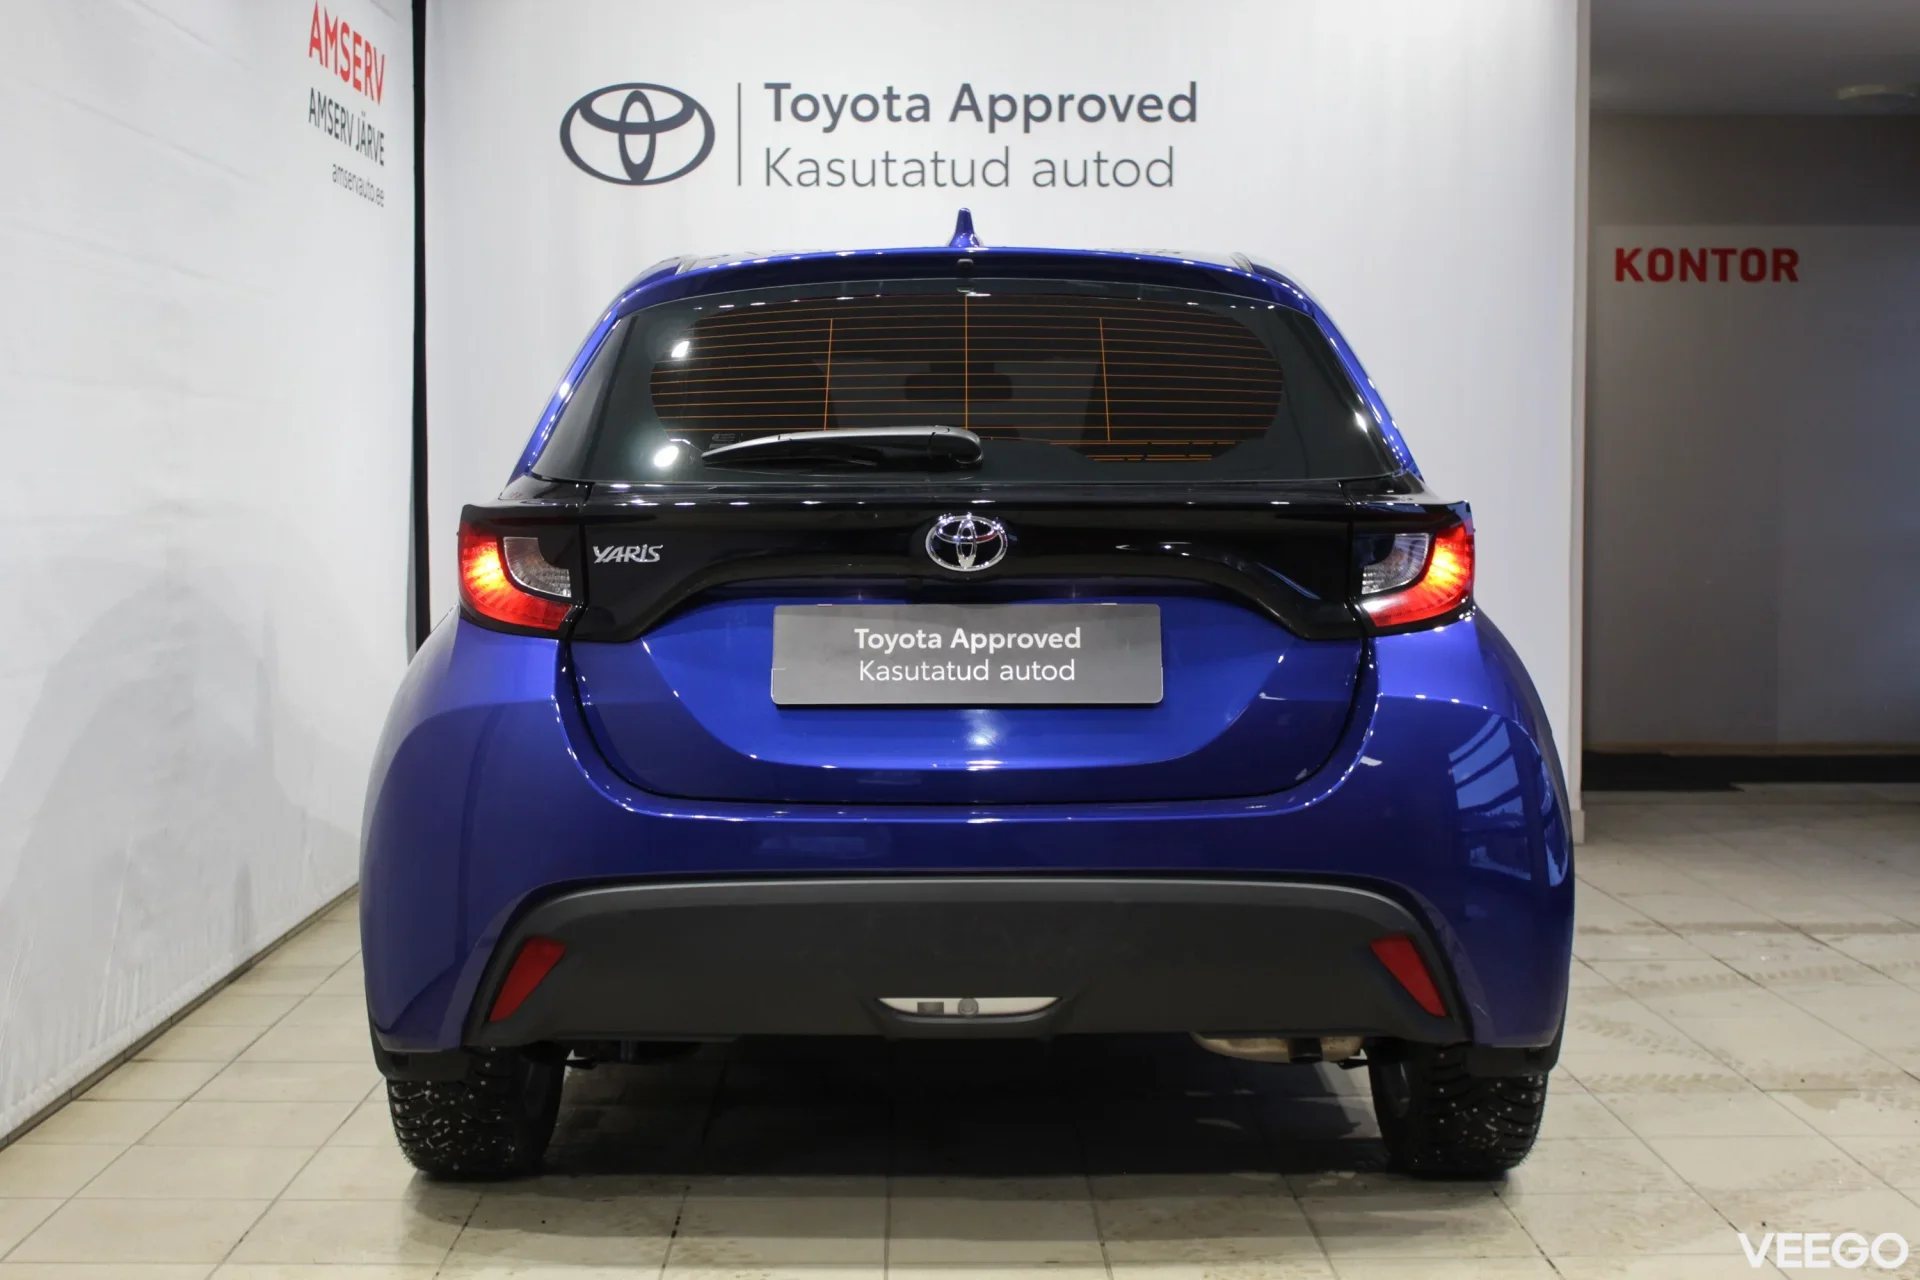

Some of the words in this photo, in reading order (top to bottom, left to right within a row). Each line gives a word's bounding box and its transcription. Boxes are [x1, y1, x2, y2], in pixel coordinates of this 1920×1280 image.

[308, 0, 385, 105] AMSERV
[308, 87, 354, 147] AMSERV
[355, 110, 385, 166] JÄRVE
[764, 82, 931, 133] Toyota
[949, 81, 1198, 133] Approved
[332, 163, 385, 207] amservauto.ee
[765, 146, 1009, 187] Kasutatud
[1032, 146, 1174, 187] autod
[1615, 247, 1800, 283] KONTOR
[592, 543, 664, 564] YARIS
[854, 627, 943, 654] Toyota
[950, 626, 1082, 654] Approved
[859, 659, 989, 682] Kasutatud
[999, 658, 1076, 681] autod
